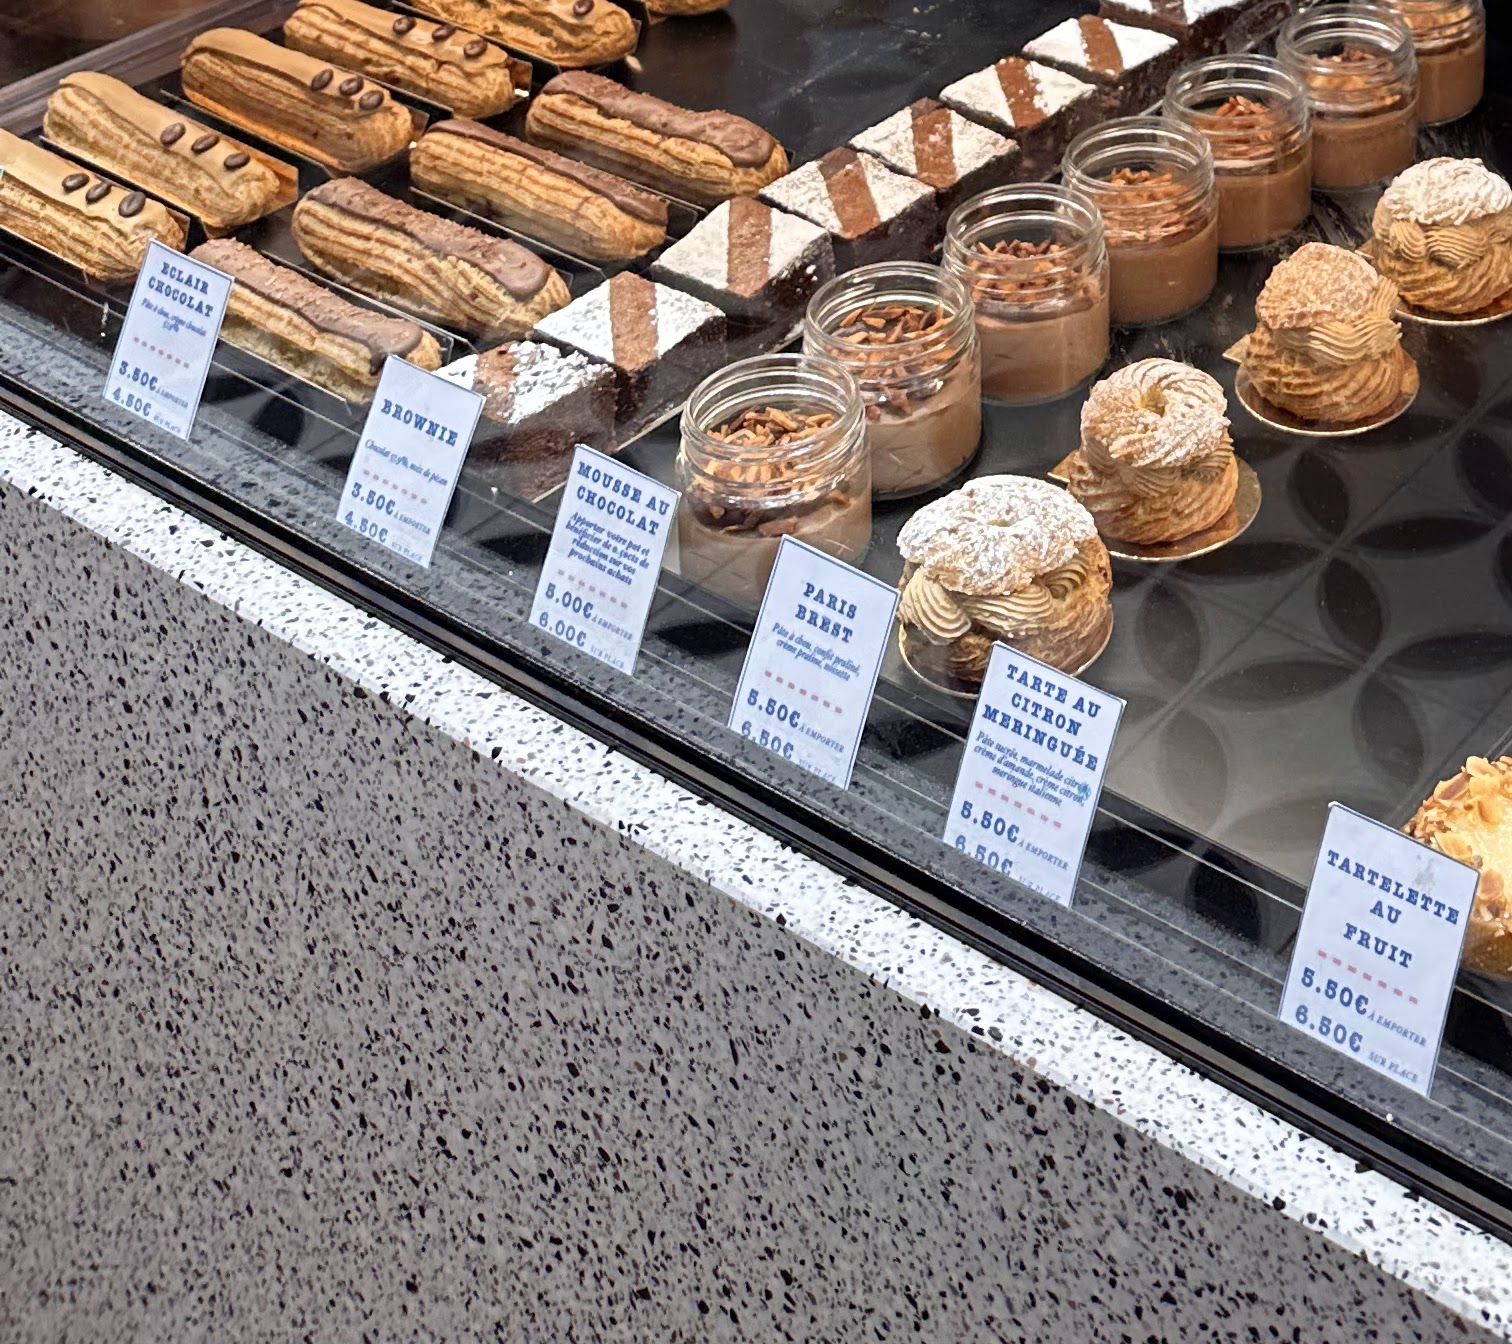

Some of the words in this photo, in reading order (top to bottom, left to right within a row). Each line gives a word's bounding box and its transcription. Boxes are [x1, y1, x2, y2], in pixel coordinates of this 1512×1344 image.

[148, 276, 214, 318] CHOCOLAT
[161, 262, 209, 295] ECLAIR
[119, 361, 158, 392] 3.50€
[381, 399, 459, 447] BROWNIE
[351, 482, 396, 516] 3.50€
[578, 461, 642, 503] MOUSSE
[646, 496, 670, 515] AU
[345, 510, 388, 543] 4.50€
[577, 485, 659, 536] CHOCOLAT
[545, 582, 594, 620] 5.00€
[803, 582, 858, 620] PARIS
[539, 611, 587, 647] 6.00€
[795, 604, 854, 644] BREST
[747, 688, 801, 728] 5.50€
[1007, 664, 1068, 704] TARTE
[1072, 696, 1101, 718] AU
[1011, 693, 1082, 736] CITRON
[741, 720, 794, 760] 6.50€
[982, 704, 1099, 772] MERINGUÉE
[960, 800, 1020, 844] 5.50€
[1327, 849, 1459, 925] TARTELETTE
[1370, 900, 1402, 924] AU
[1343, 923, 1412, 968] FRUIT
[1301, 967, 1370, 1016] 5.50€
[1295, 1004, 1363, 1053] 6.50€
